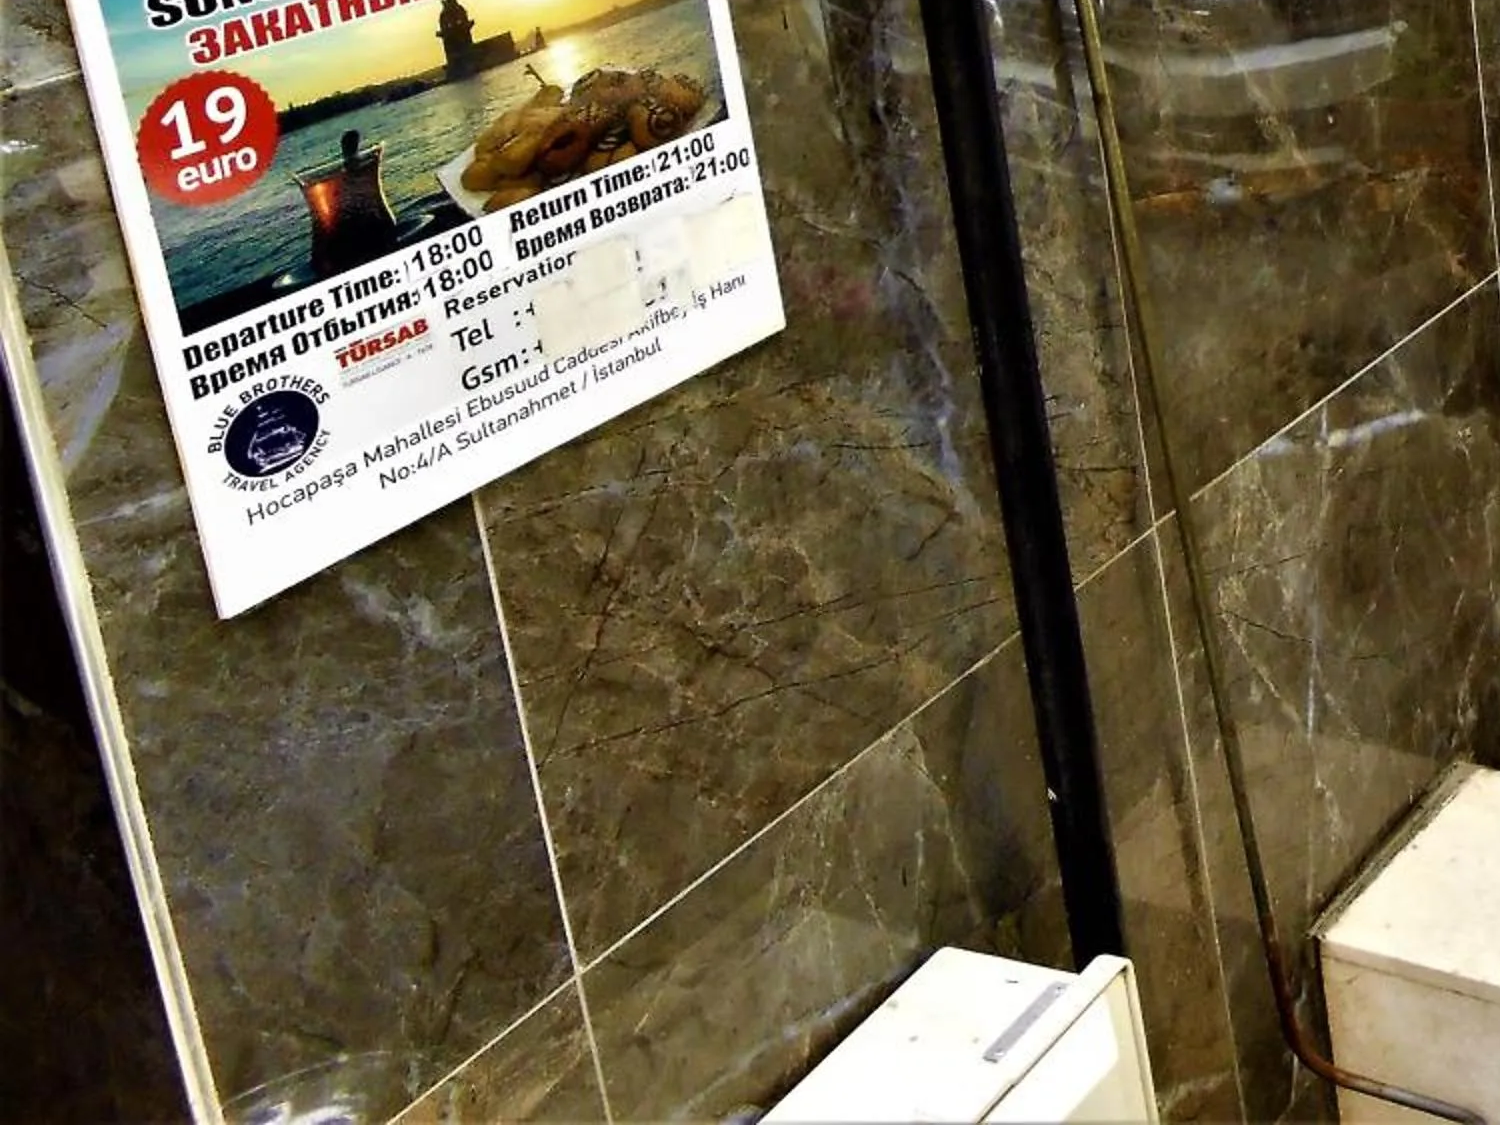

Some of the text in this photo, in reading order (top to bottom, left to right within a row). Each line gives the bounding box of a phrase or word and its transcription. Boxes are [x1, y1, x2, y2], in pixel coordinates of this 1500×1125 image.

[160, 86, 247, 161] 19
[177, 146, 258, 192] euro
[508, 132, 715, 233] Return Time: 21:00
[515, 148, 750, 261] Время Возврата: 21:00
[182, 296, 324, 370] Departure
[328, 266, 401, 311] Time:
[412, 225, 483, 272] 18:00
[189, 345, 287, 401] Время
[423, 249, 493, 298] 18:00
[450, 318, 494, 352] Tel
[207, 374, 331, 454] BLUE BROTHERS
[222, 429, 331, 492] TRAVEL AGENCY
[246, 461, 358, 526] Hocapaşa
[362, 406, 462, 468] Mahallesi
[466, 364, 550, 418] Ebusuud
[379, 441, 453, 489] No:4/A
[456, 382, 578, 451] Sultanahmet
